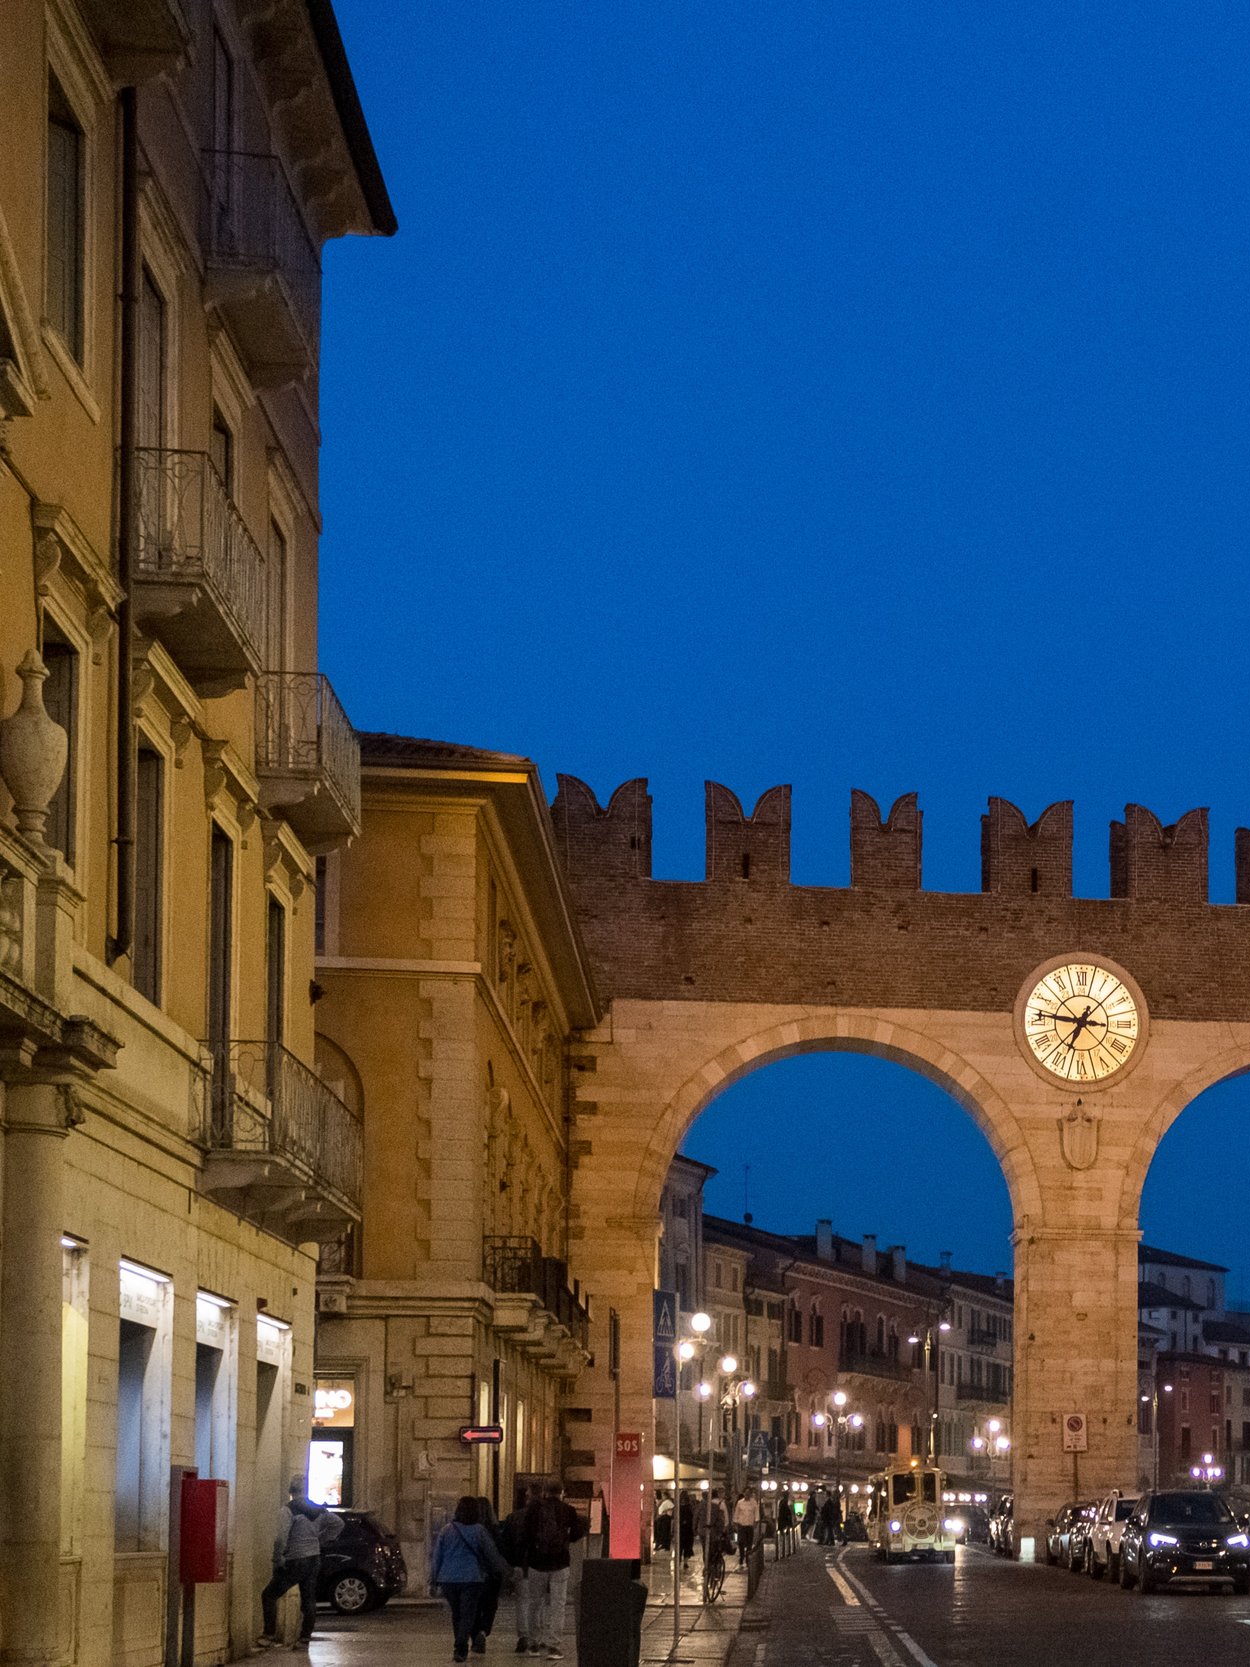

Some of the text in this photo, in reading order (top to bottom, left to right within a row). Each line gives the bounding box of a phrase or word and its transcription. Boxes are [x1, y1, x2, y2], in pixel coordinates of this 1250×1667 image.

[1053, 975, 1066, 992] XI
[1076, 971, 1087, 986] XII
[1036, 993, 1052, 1006] X
[1111, 996, 1126, 1008] II
[1117, 1020, 1131, 1028] III
[1051, 1051, 1067, 1070] VII
[1077, 1060, 1087, 1075] VI
[1099, 1056, 1110, 1071] V
[616, 1440, 638, 1452] SOS
